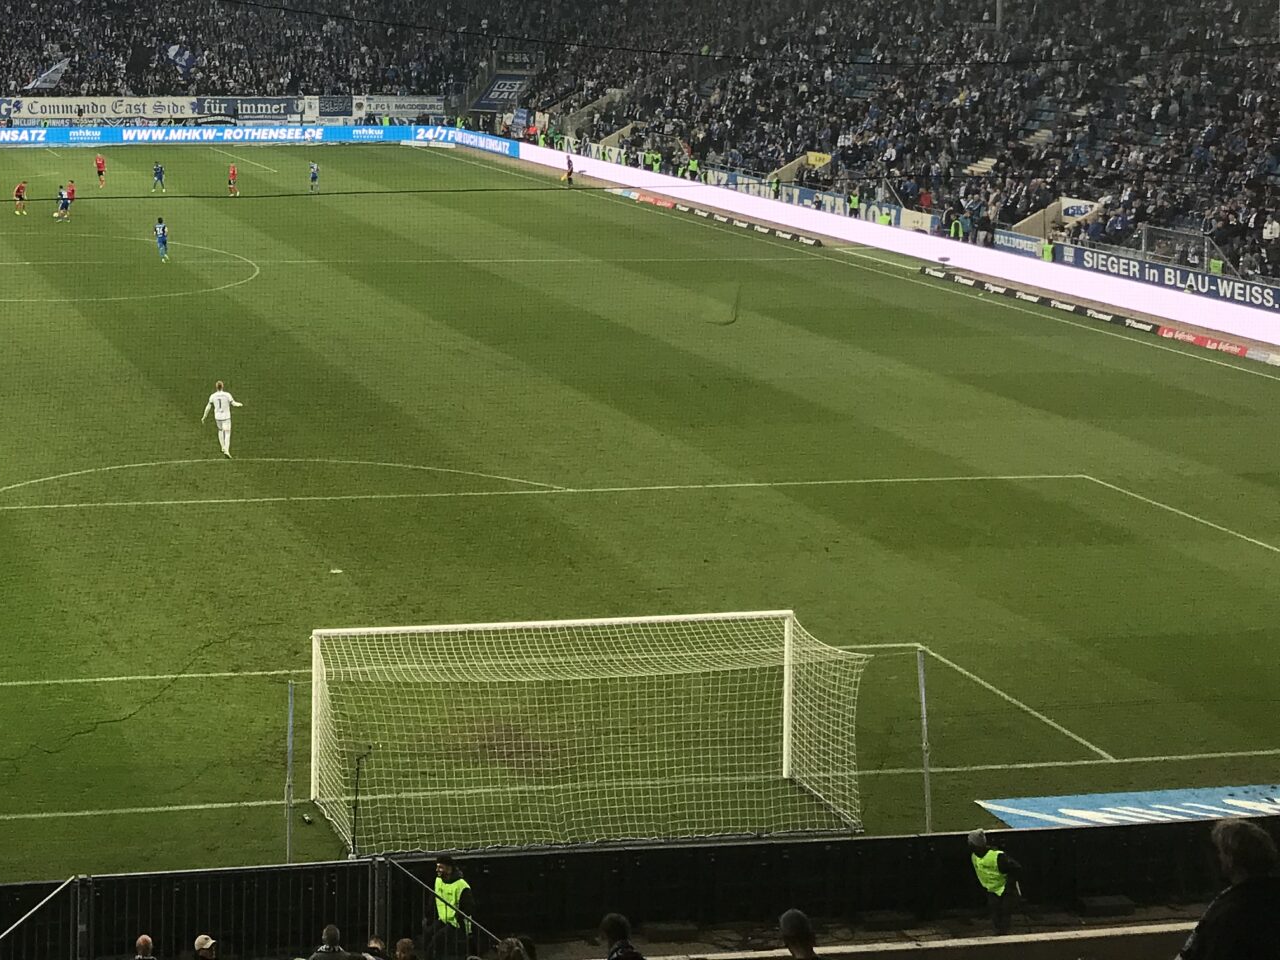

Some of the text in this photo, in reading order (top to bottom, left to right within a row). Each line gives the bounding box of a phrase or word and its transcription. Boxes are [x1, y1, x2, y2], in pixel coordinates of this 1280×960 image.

[27, 100, 108, 116] Commando
[203, 98, 286, 115] für immer
[70, 129, 101, 137] mhkw
[122, 128, 324, 141] WWW.MHKW-ROTHENSEE.DE
[416, 126, 446, 141] 24/7
[1083, 251, 1279, 309] SIEGER in BLAU-WEISS.
